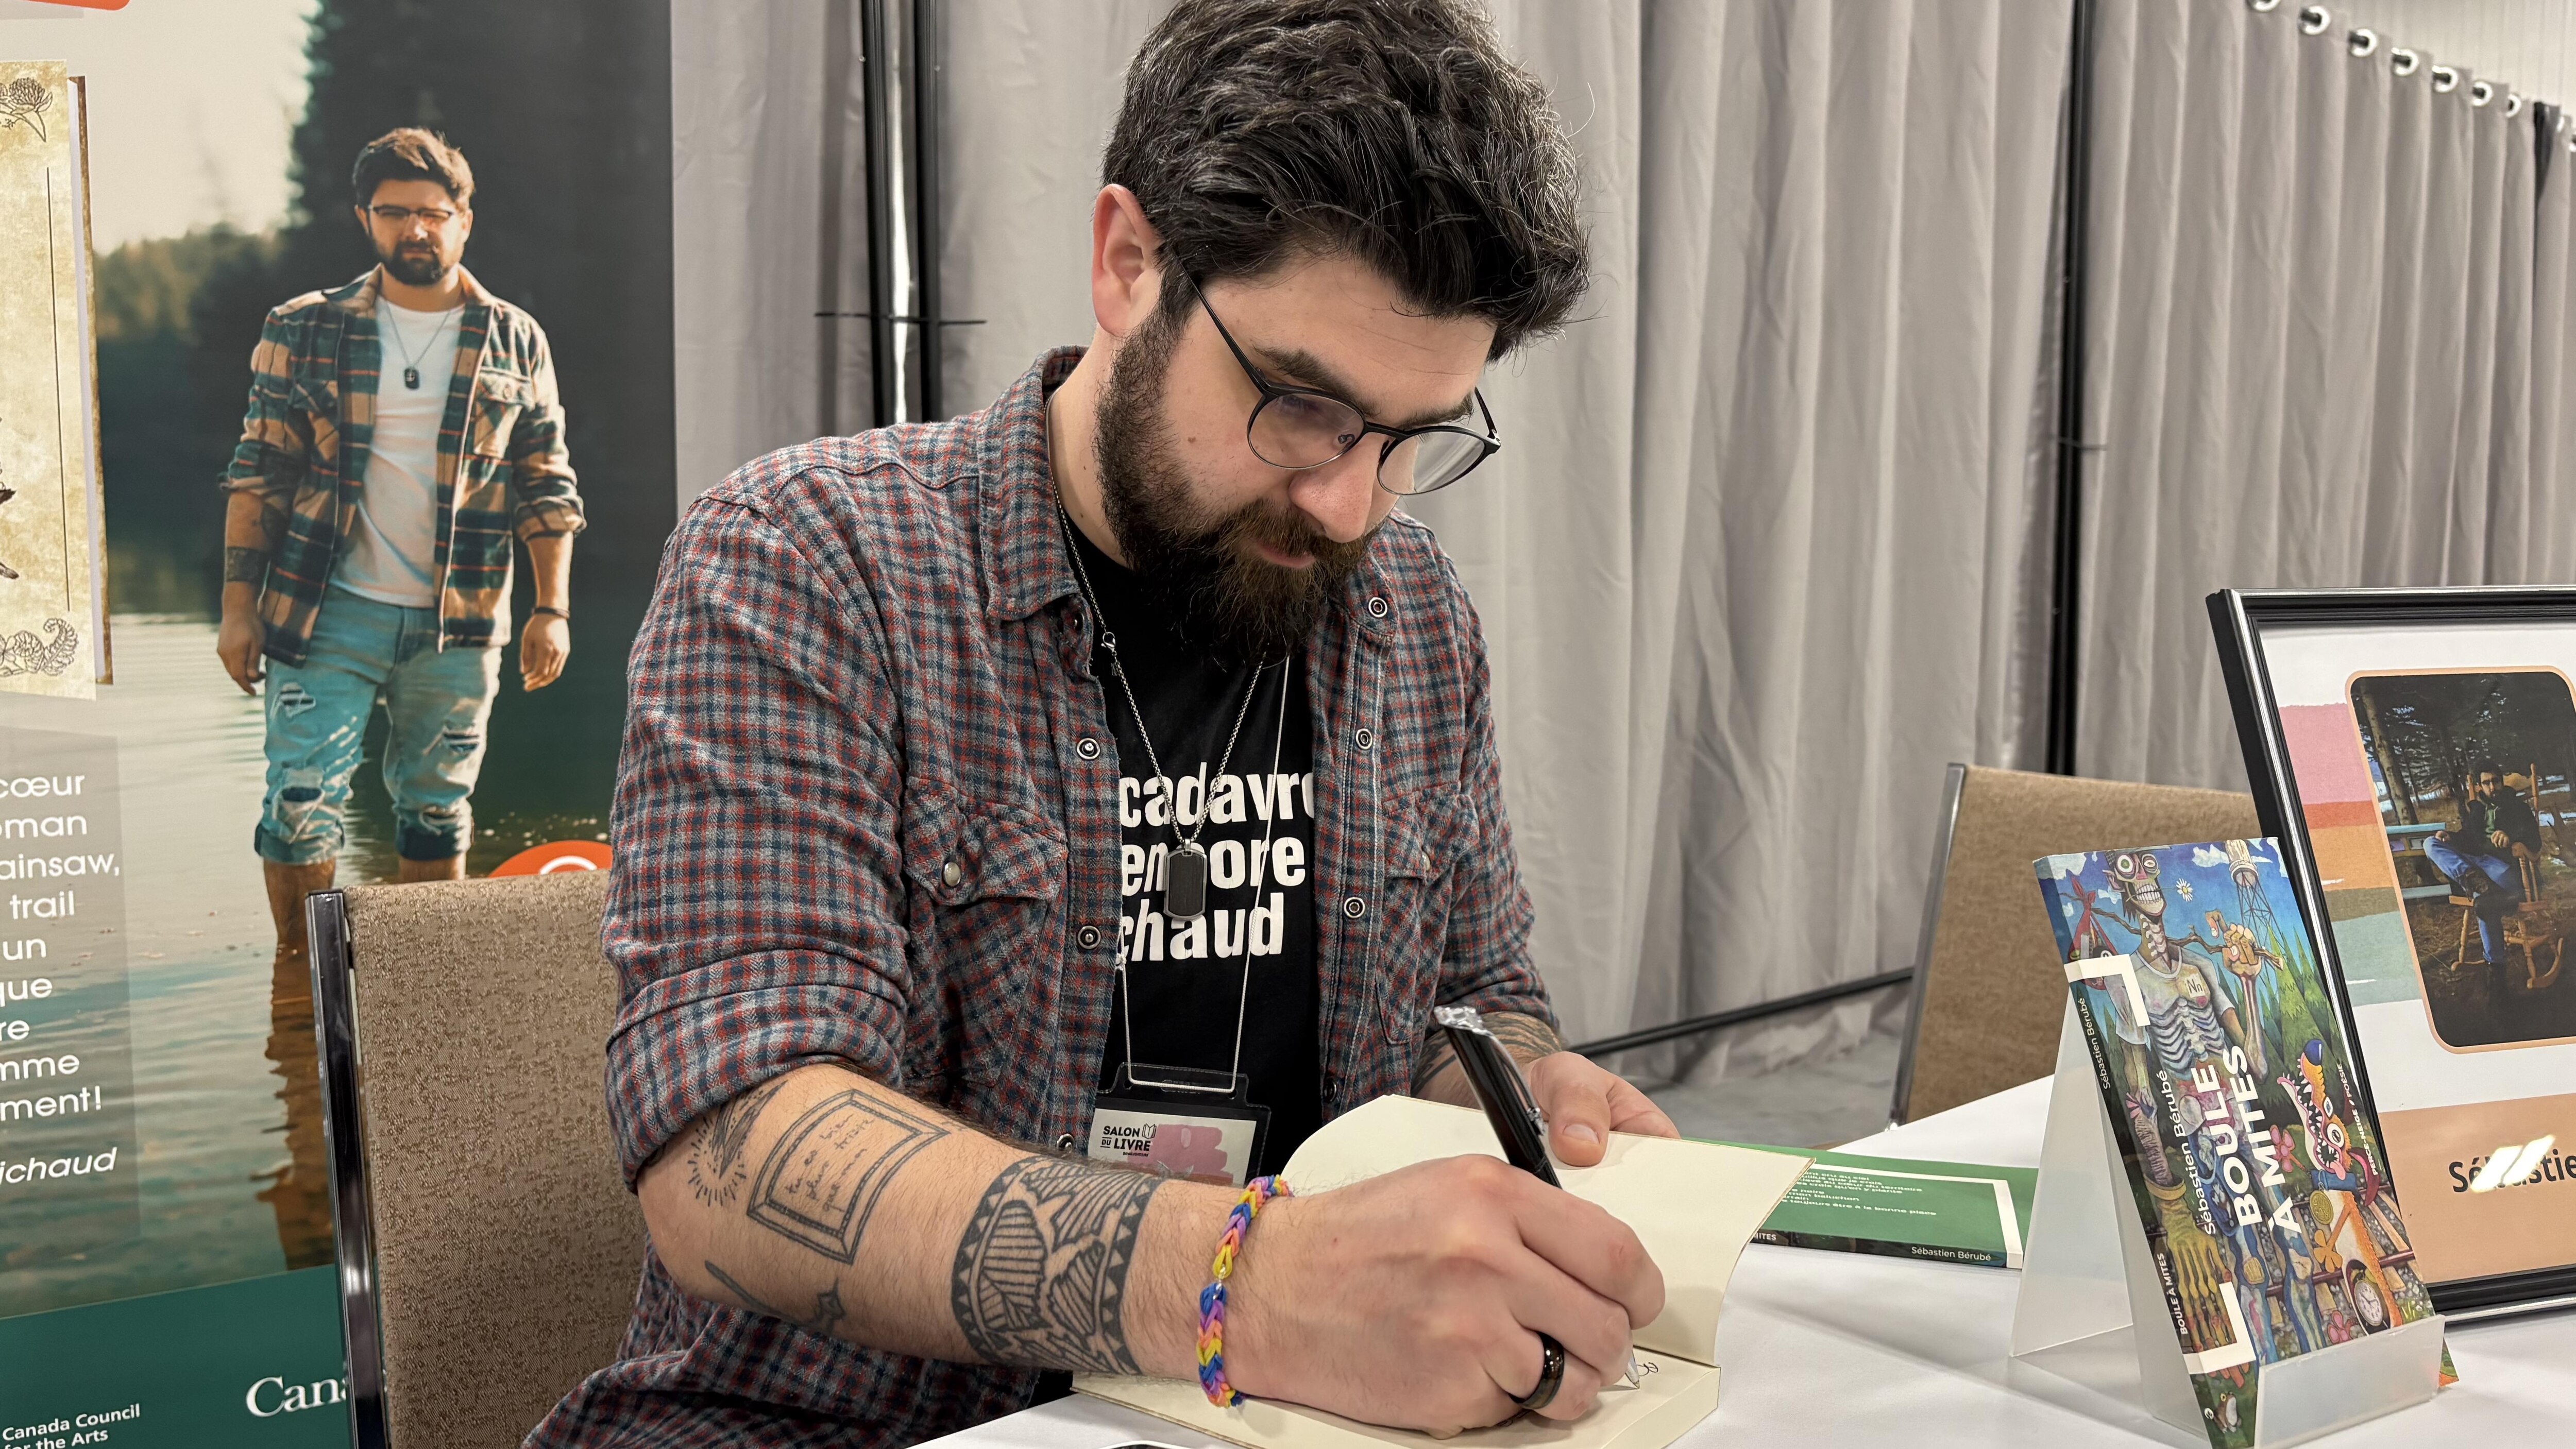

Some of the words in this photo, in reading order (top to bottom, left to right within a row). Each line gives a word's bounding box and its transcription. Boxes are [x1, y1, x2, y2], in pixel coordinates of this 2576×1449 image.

[0, 815, 87, 839] man
[0, 854, 119, 880] ainsaw,
[1122, 837, 1306, 896] enore
[9, 890, 75, 919] trail
[3, 939, 46, 961] un
[0, 978, 53, 1007] ue
[2187, 979, 2203, 994] Nn
[2078, 997, 2095, 1036] Bérubé
[2091, 1037, 2111, 1090] Sébastien
[2336, 1063, 2352, 1098] POÉSIE
[0, 1085, 101, 1121] ment!
[2156, 1069, 2186, 1138] Bérubé
[2223, 1046, 2286, 1187] MITES
[1103, 1126, 1140, 1137] SALON
[1113, 1138, 1151, 1151] LIVRE
[2191, 1065, 2263, 1226] BOULE
[2352, 1108, 2379, 1175] PERCE-NEIGE
[0, 1147, 117, 1184] ichaud
[2449, 1148, 2576, 1192] Séstie
[2183, 1143, 2216, 1235] Sébastien
[2267, 1196, 2302, 1234] À
[1911, 1247, 1955, 1258] Sébastien
[1958, 1251, 1991, 1261] Bérubé
[2157, 1253, 2173, 1286] MITES
[2166, 1287, 2177, 1296] À
[2171, 1298, 2189, 1335] BOULE
[3, 1418, 70, 1441] Canada
[76, 1403, 140, 1427] Council
[36, 1438, 66, 1449] the
[71, 1430, 108, 1446] Arts
